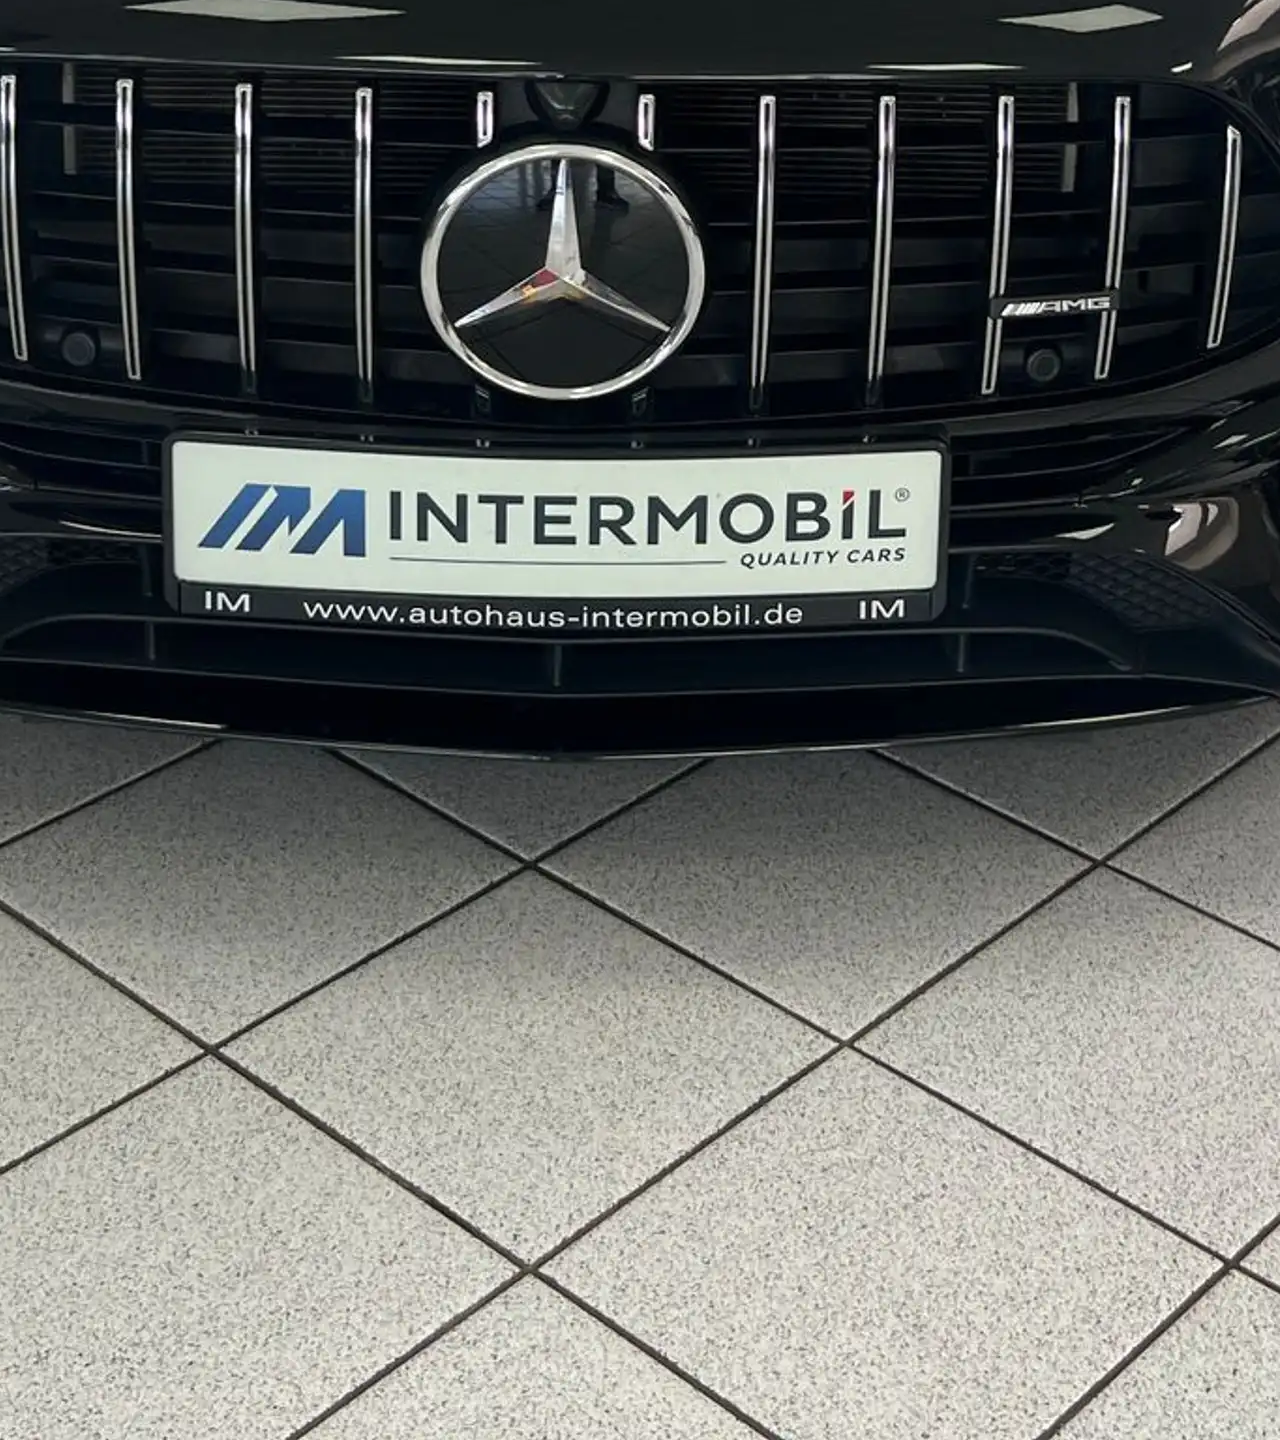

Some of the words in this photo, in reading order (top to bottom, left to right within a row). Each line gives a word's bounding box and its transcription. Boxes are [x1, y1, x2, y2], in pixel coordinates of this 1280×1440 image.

[740, 550, 839, 569] QUALITY
[847, 547, 906, 563] CARS
[204, 590, 252, 613] IM
[303, 601, 803, 629] www.autohaus-intermobil.de
[859, 598, 905, 621] IM
